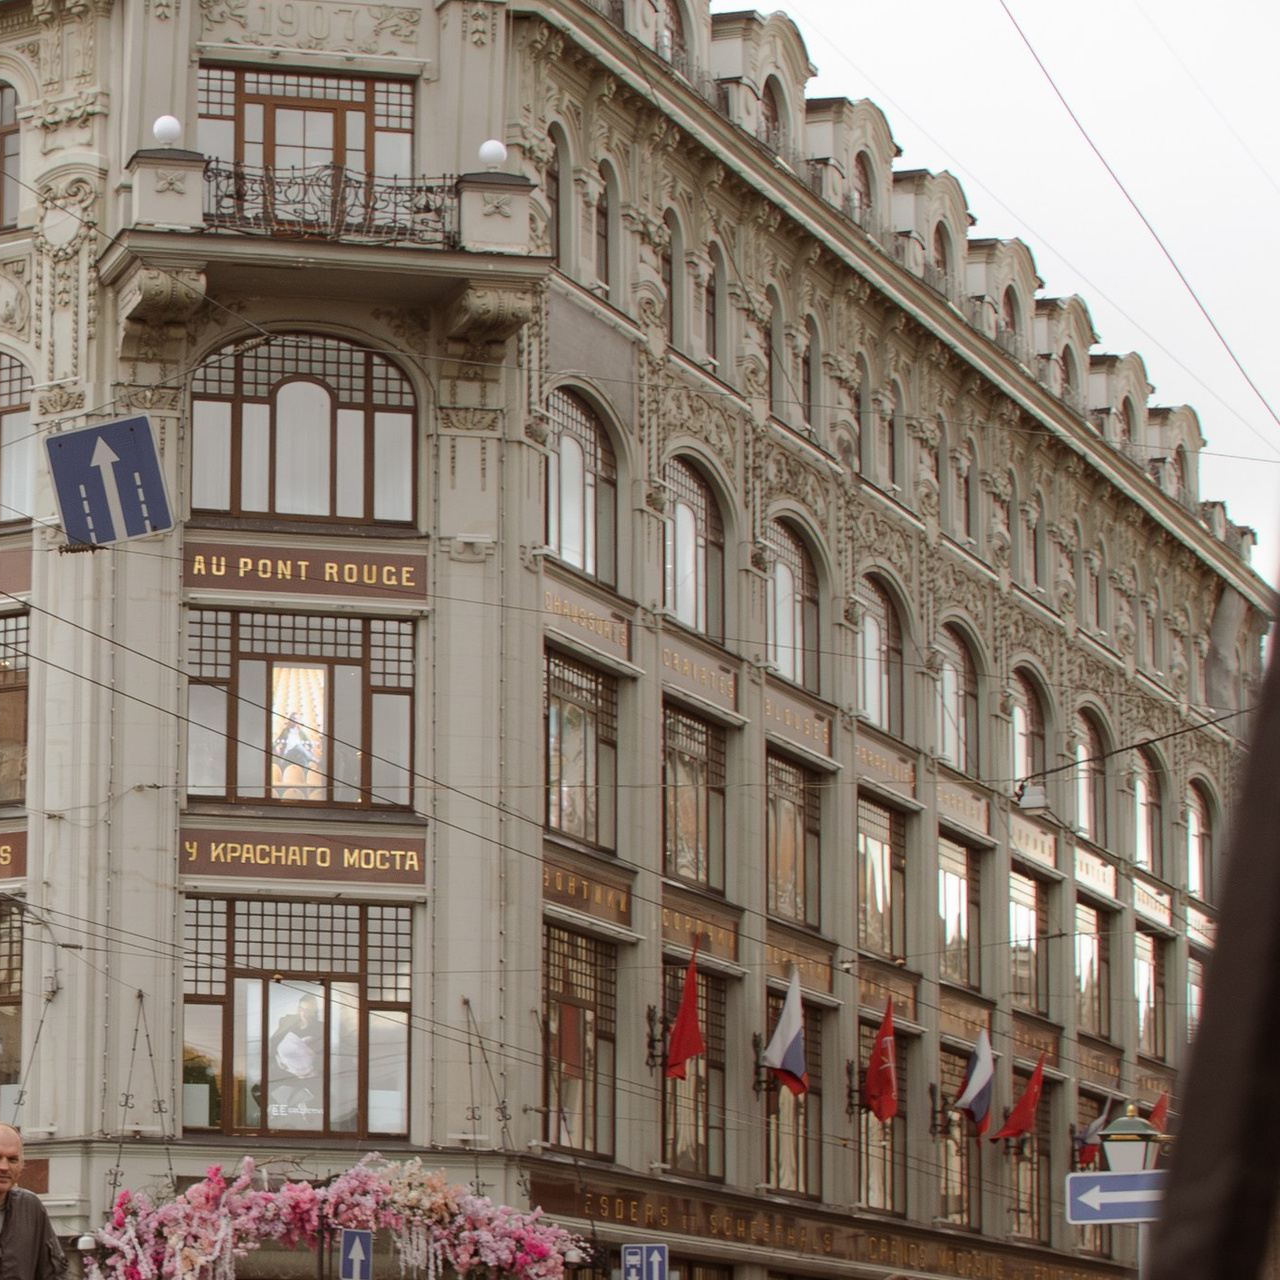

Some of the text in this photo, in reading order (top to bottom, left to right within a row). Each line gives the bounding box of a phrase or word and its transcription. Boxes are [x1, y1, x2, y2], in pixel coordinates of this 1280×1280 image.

[257, 1, 360, 42] 1907
[193, 555, 416, 587] AU PONT ROUGE
[184, 841, 419, 871] У КРАСНАГО МОСТА
[584, 1193, 669, 1226] ESDERS
